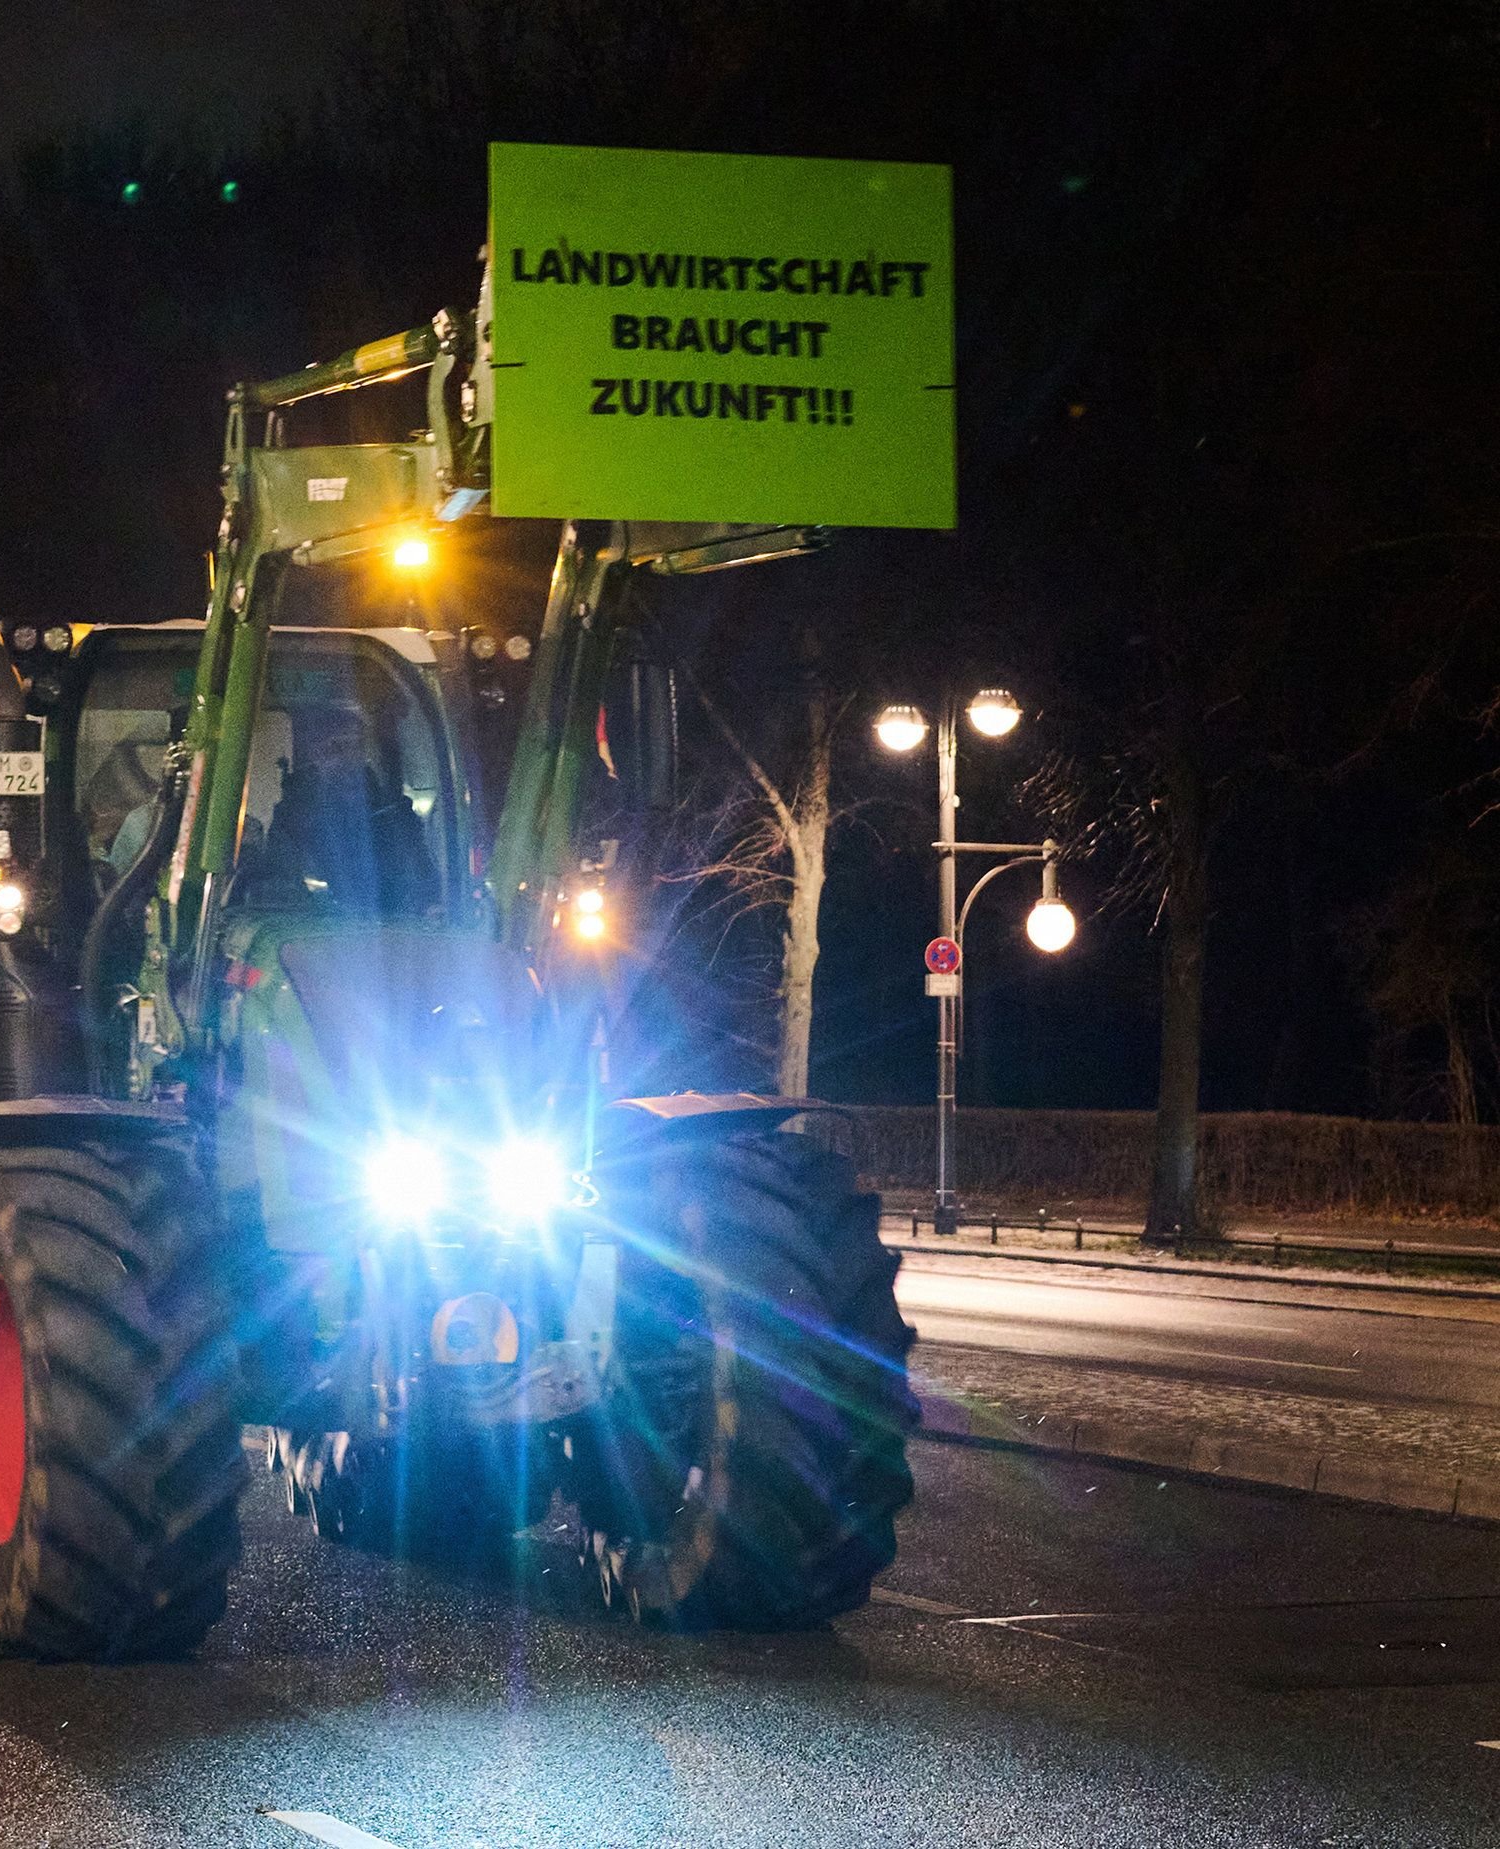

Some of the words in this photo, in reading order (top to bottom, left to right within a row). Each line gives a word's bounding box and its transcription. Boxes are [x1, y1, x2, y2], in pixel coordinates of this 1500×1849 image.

[512, 248, 930, 298] LANDWIRTSCHAFT
[611, 314, 831, 358] BRAUCHT
[589, 378, 855, 426] ZUKUNFT!!!
[4, 772, 39, 792] 724
